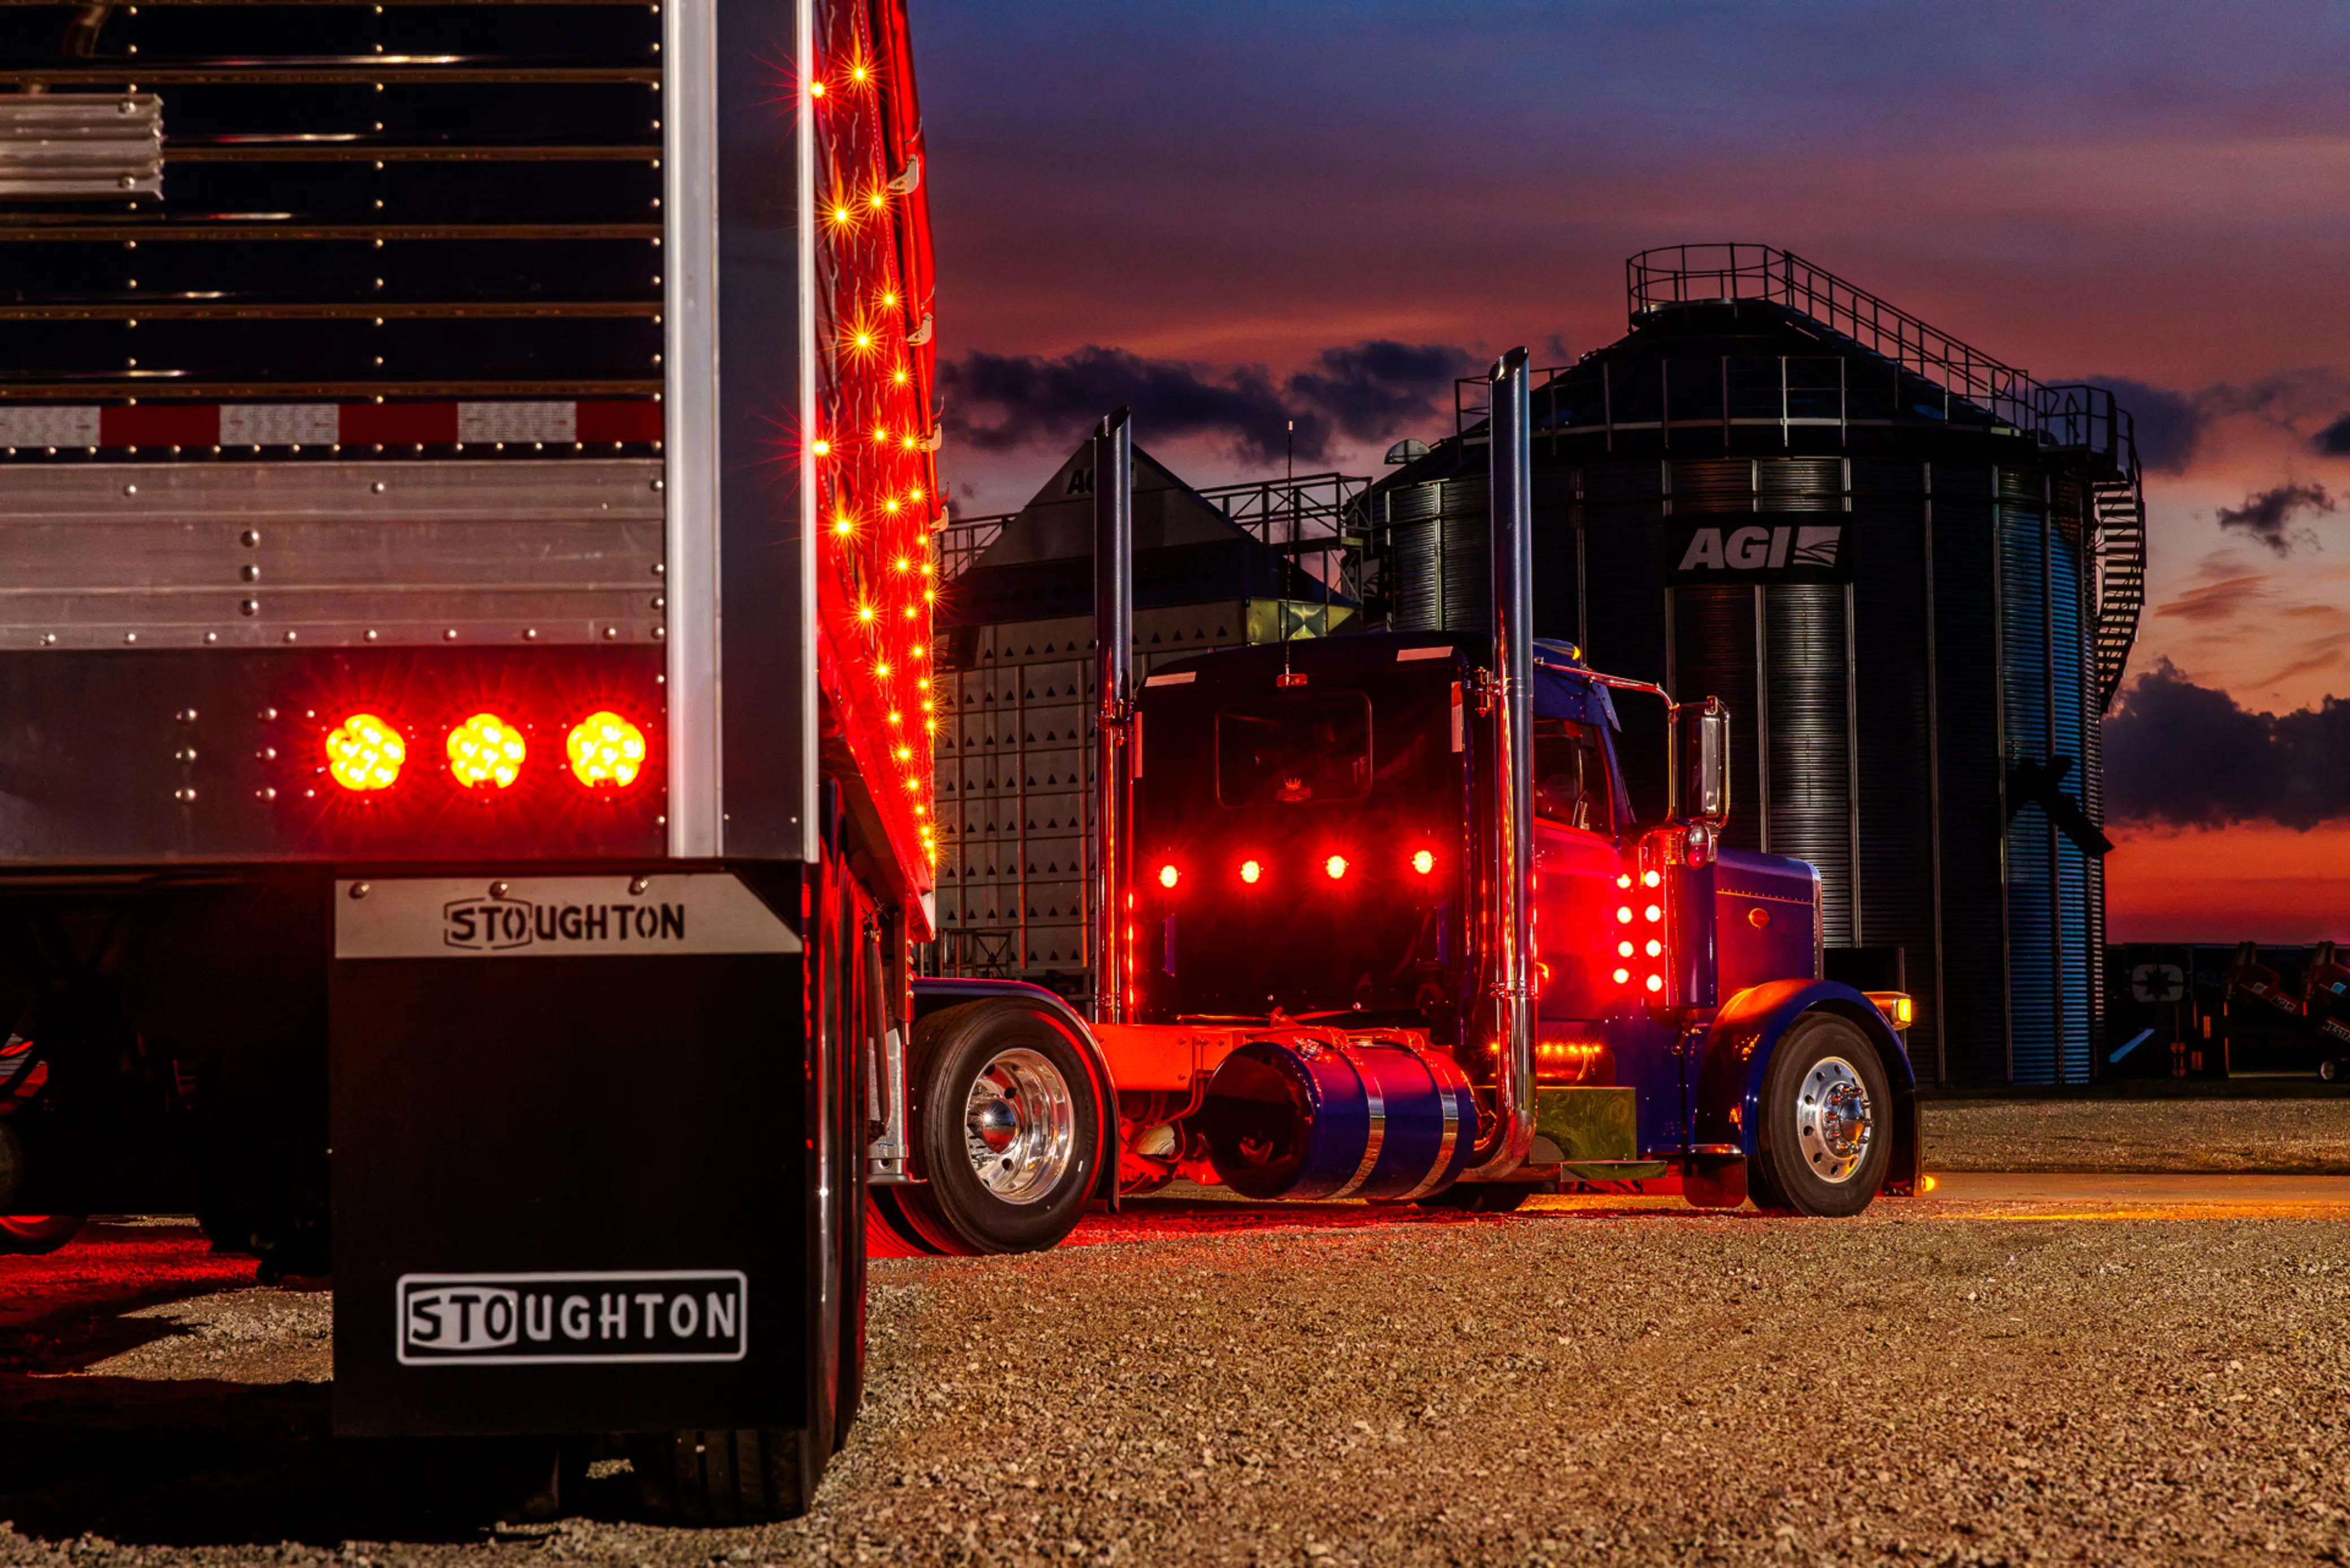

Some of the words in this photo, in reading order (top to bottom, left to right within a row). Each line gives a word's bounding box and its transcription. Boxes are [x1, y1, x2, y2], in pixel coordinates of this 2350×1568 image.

[1678, 526, 1791, 570] AGI
[451, 904, 685, 942] STOUGHTON
[411, 1292, 736, 1342] STOUGHTON
